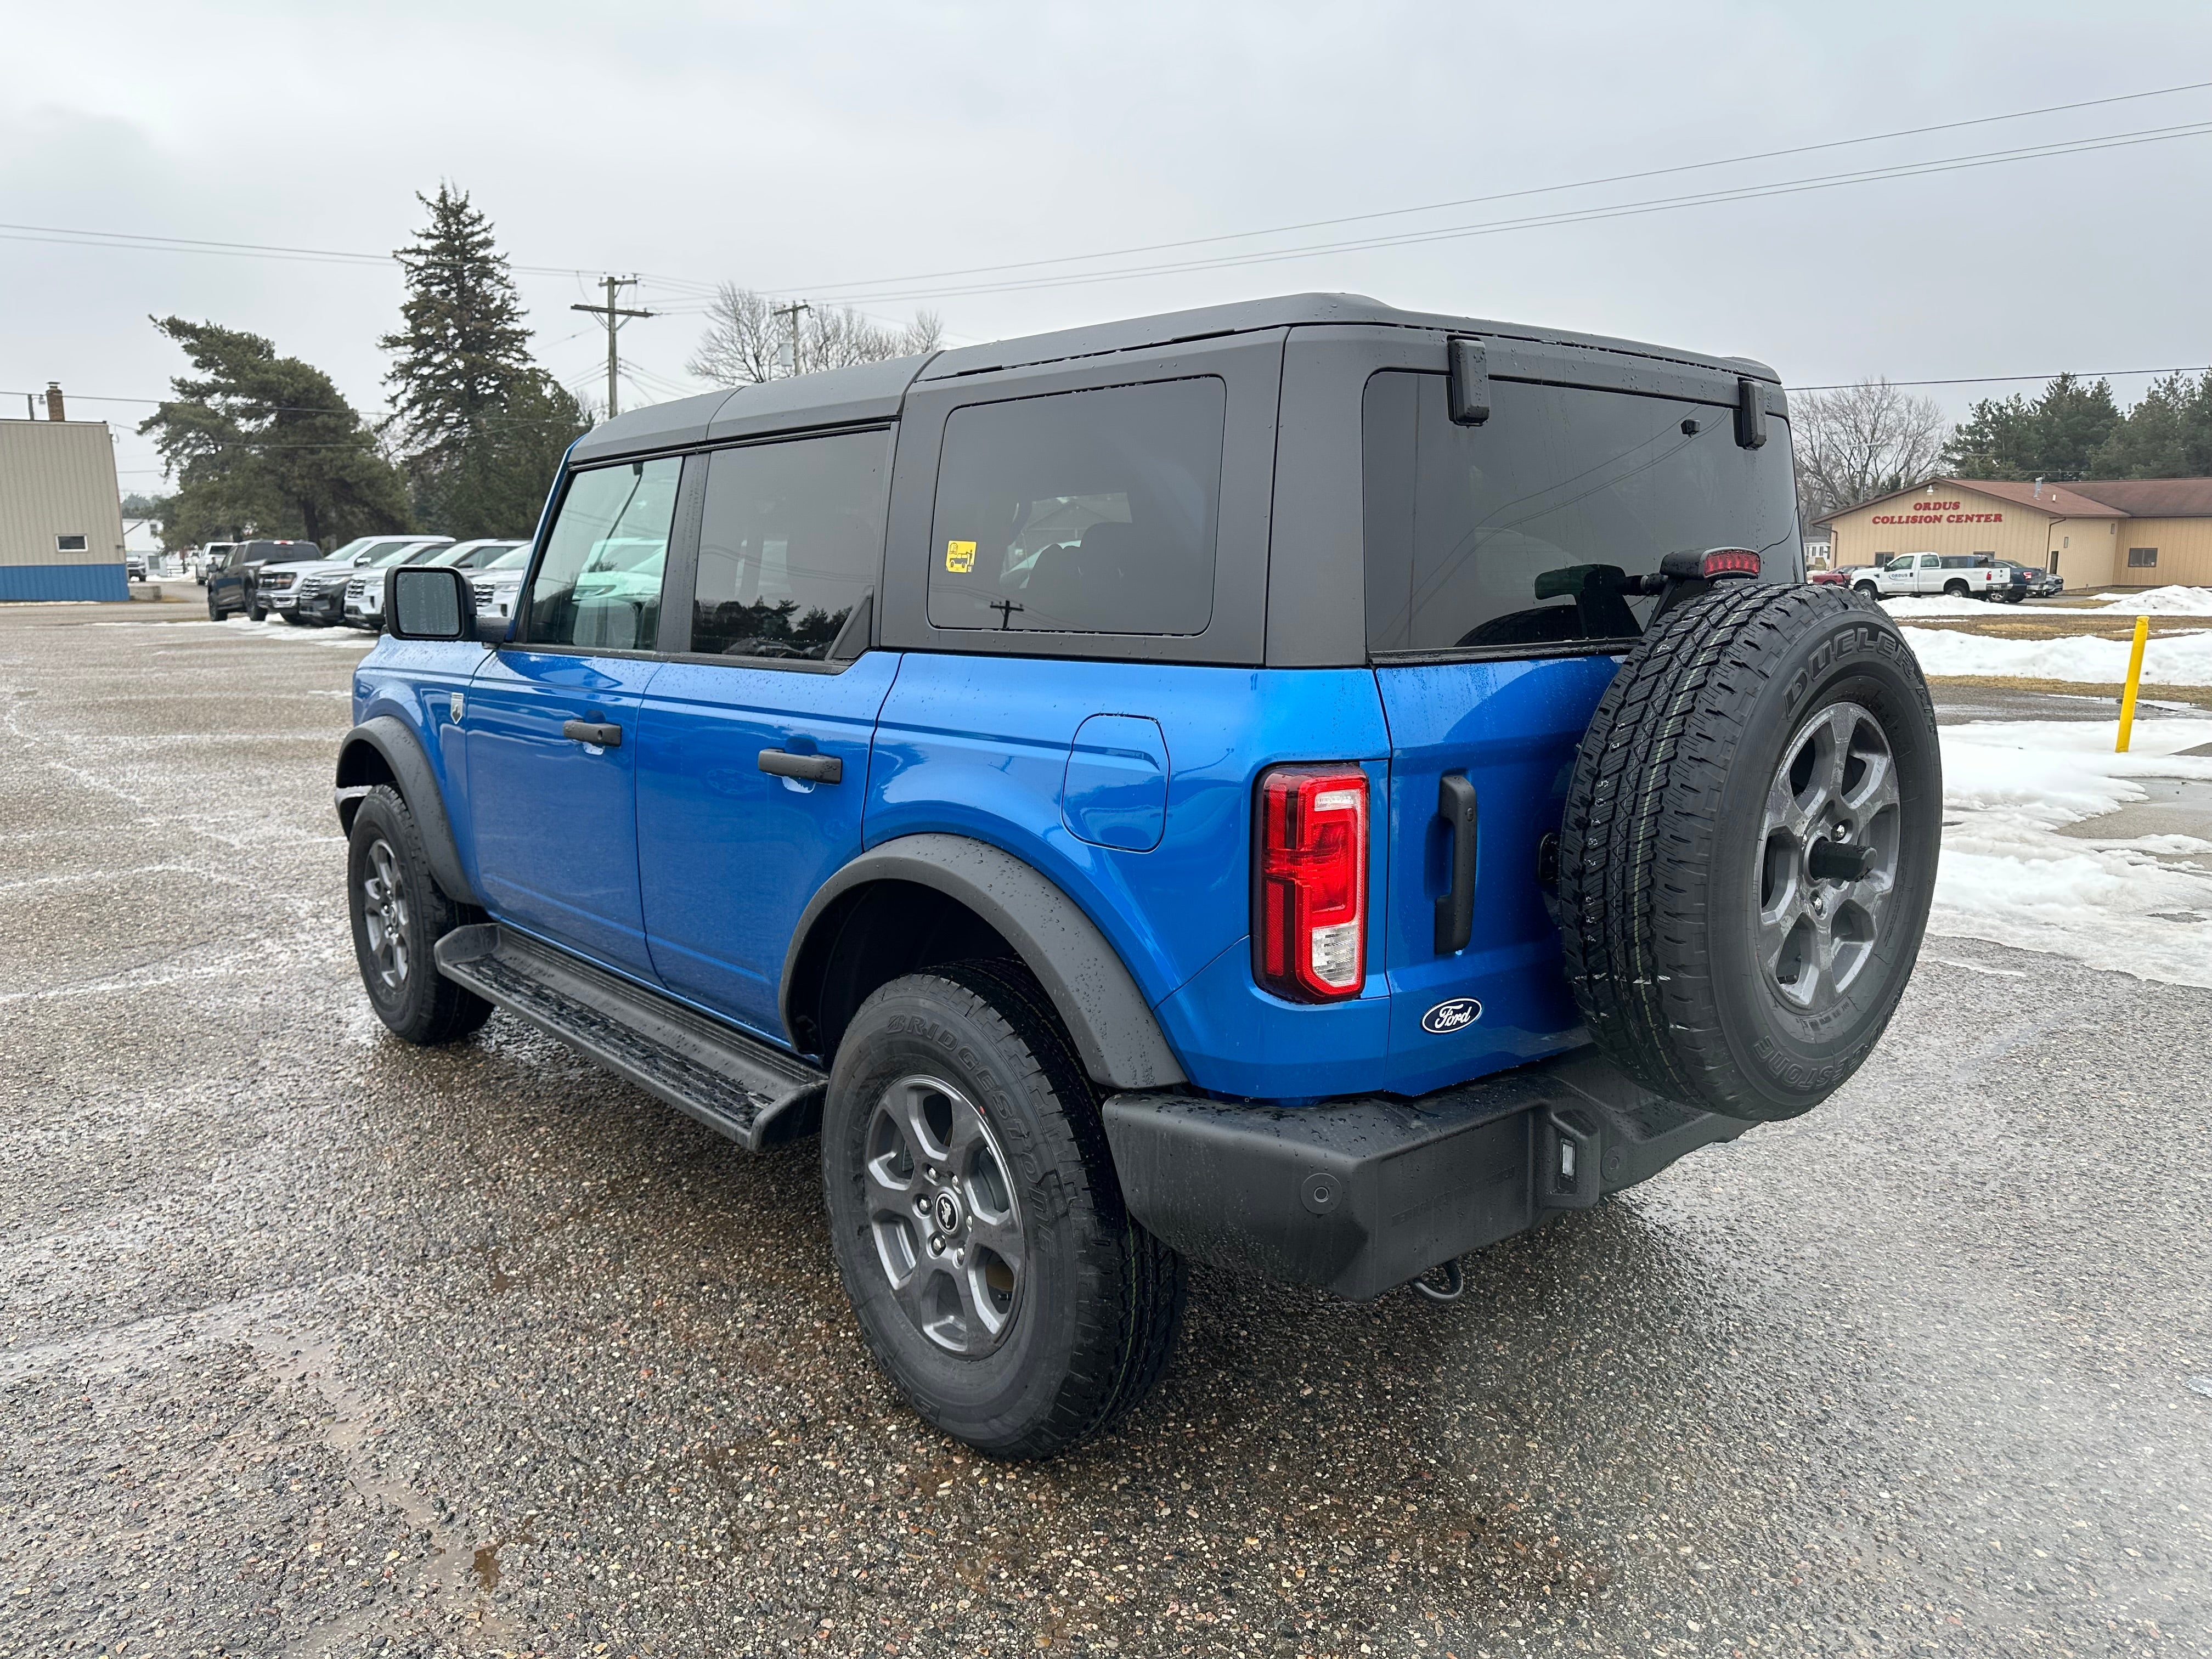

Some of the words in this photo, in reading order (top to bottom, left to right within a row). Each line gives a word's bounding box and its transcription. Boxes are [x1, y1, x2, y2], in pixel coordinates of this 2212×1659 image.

[1872, 515, 1943, 524] COLLISION
[1946, 514, 2002, 523] CENTER
[1913, 501, 1960, 511] ORDUS
[1783, 627, 1915, 719] DUELER
[1434, 1003, 1472, 1029] Ford
[884, 1012, 1058, 1259] BRIDGESTONE
